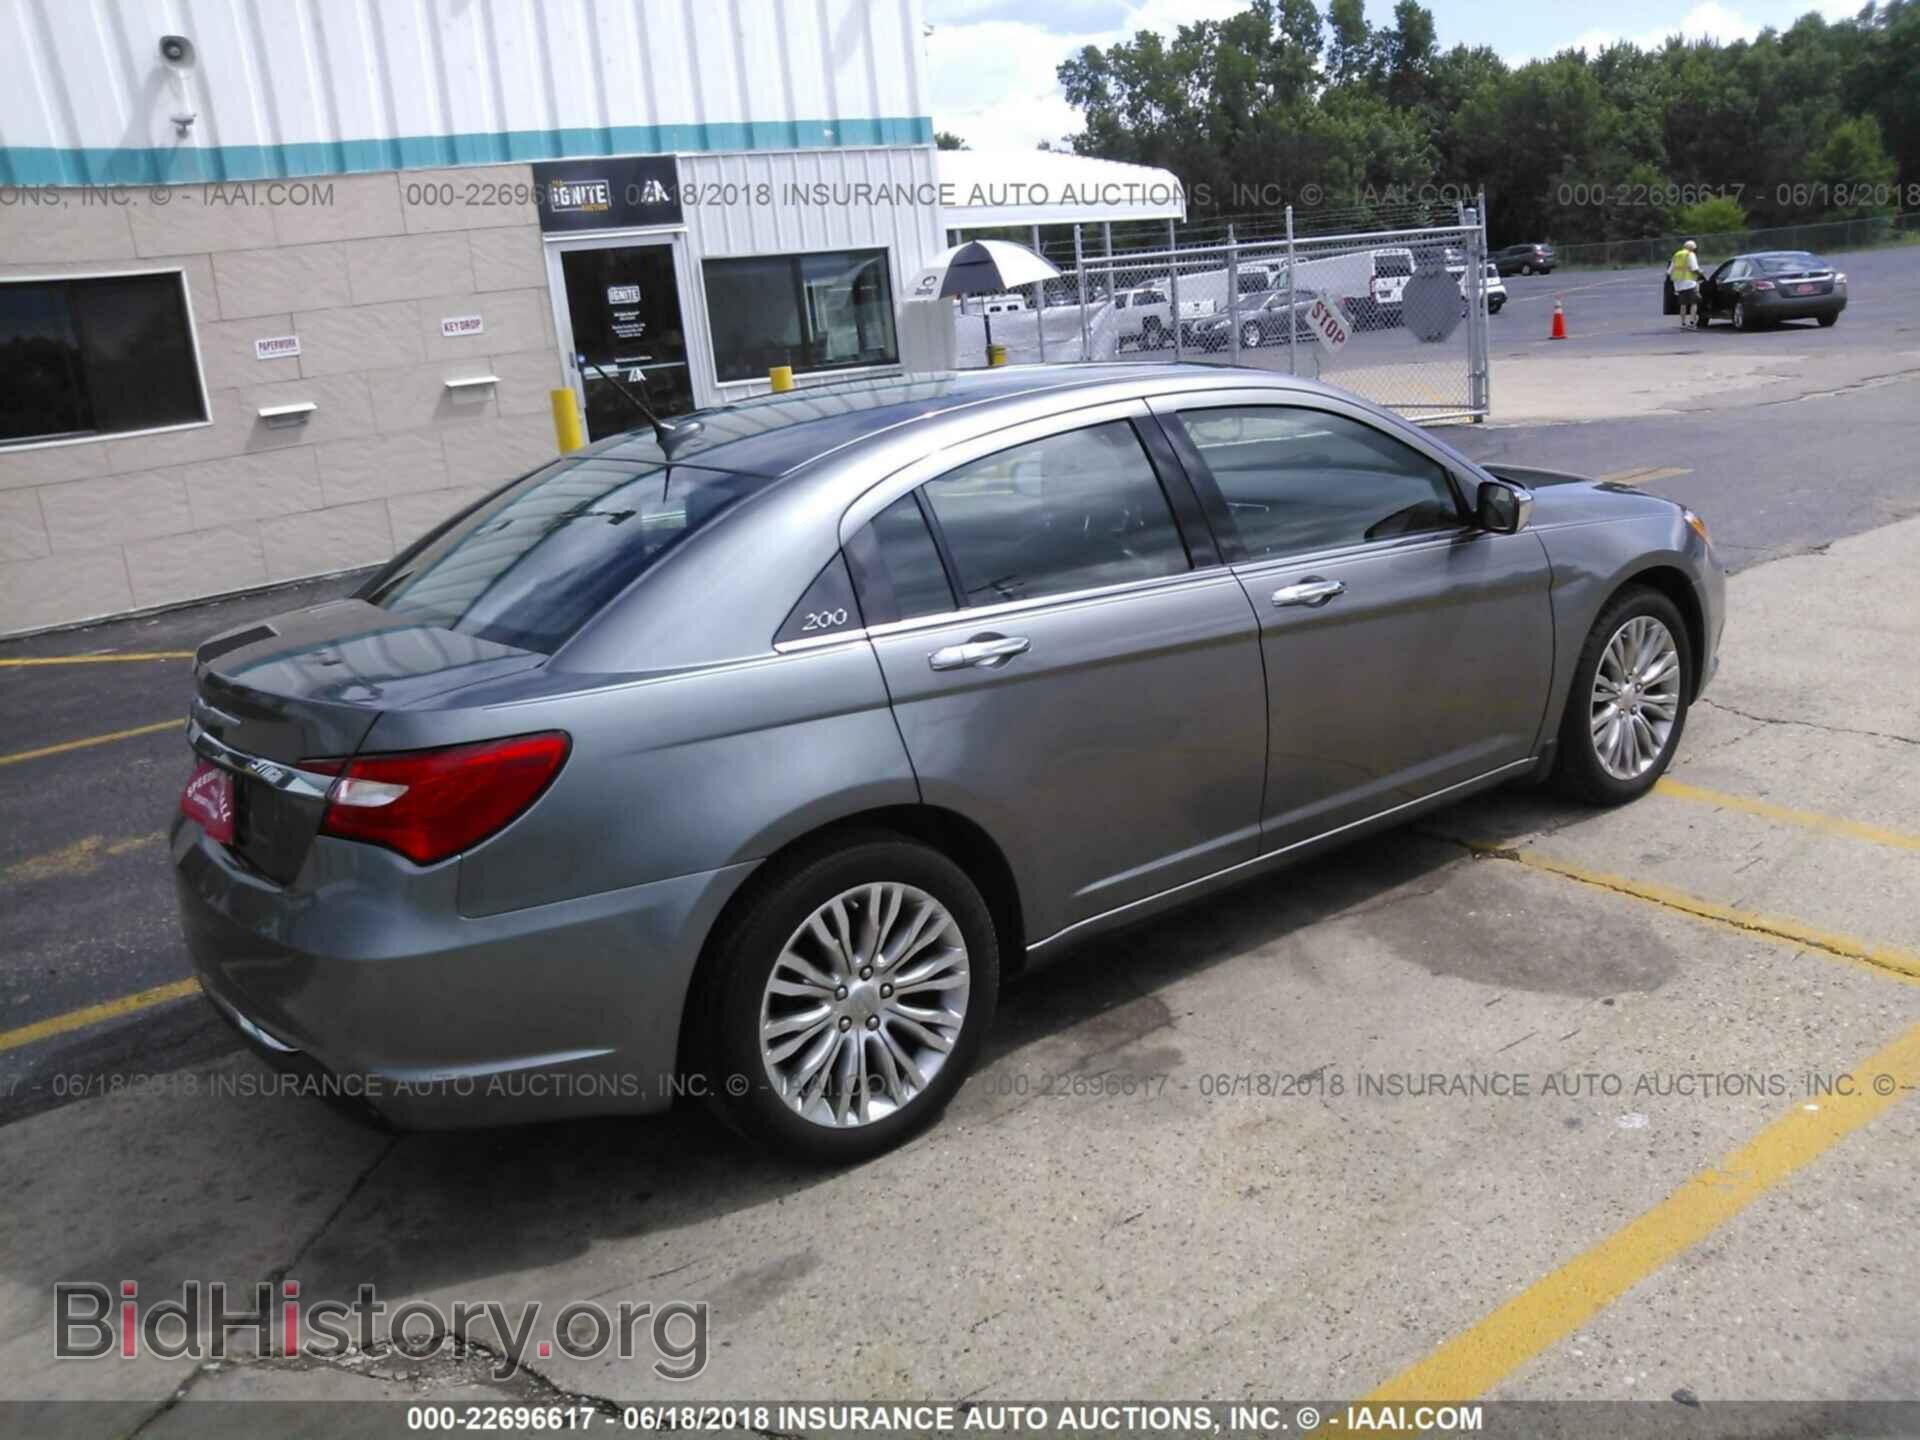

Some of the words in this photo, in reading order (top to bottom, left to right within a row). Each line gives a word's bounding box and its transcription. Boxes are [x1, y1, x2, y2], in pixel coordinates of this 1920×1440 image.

[444, 321, 459, 332] KEY
[460, 319, 480, 330] DROP
[1312, 301, 1345, 343] STOP
[802, 608, 847, 631] 200
